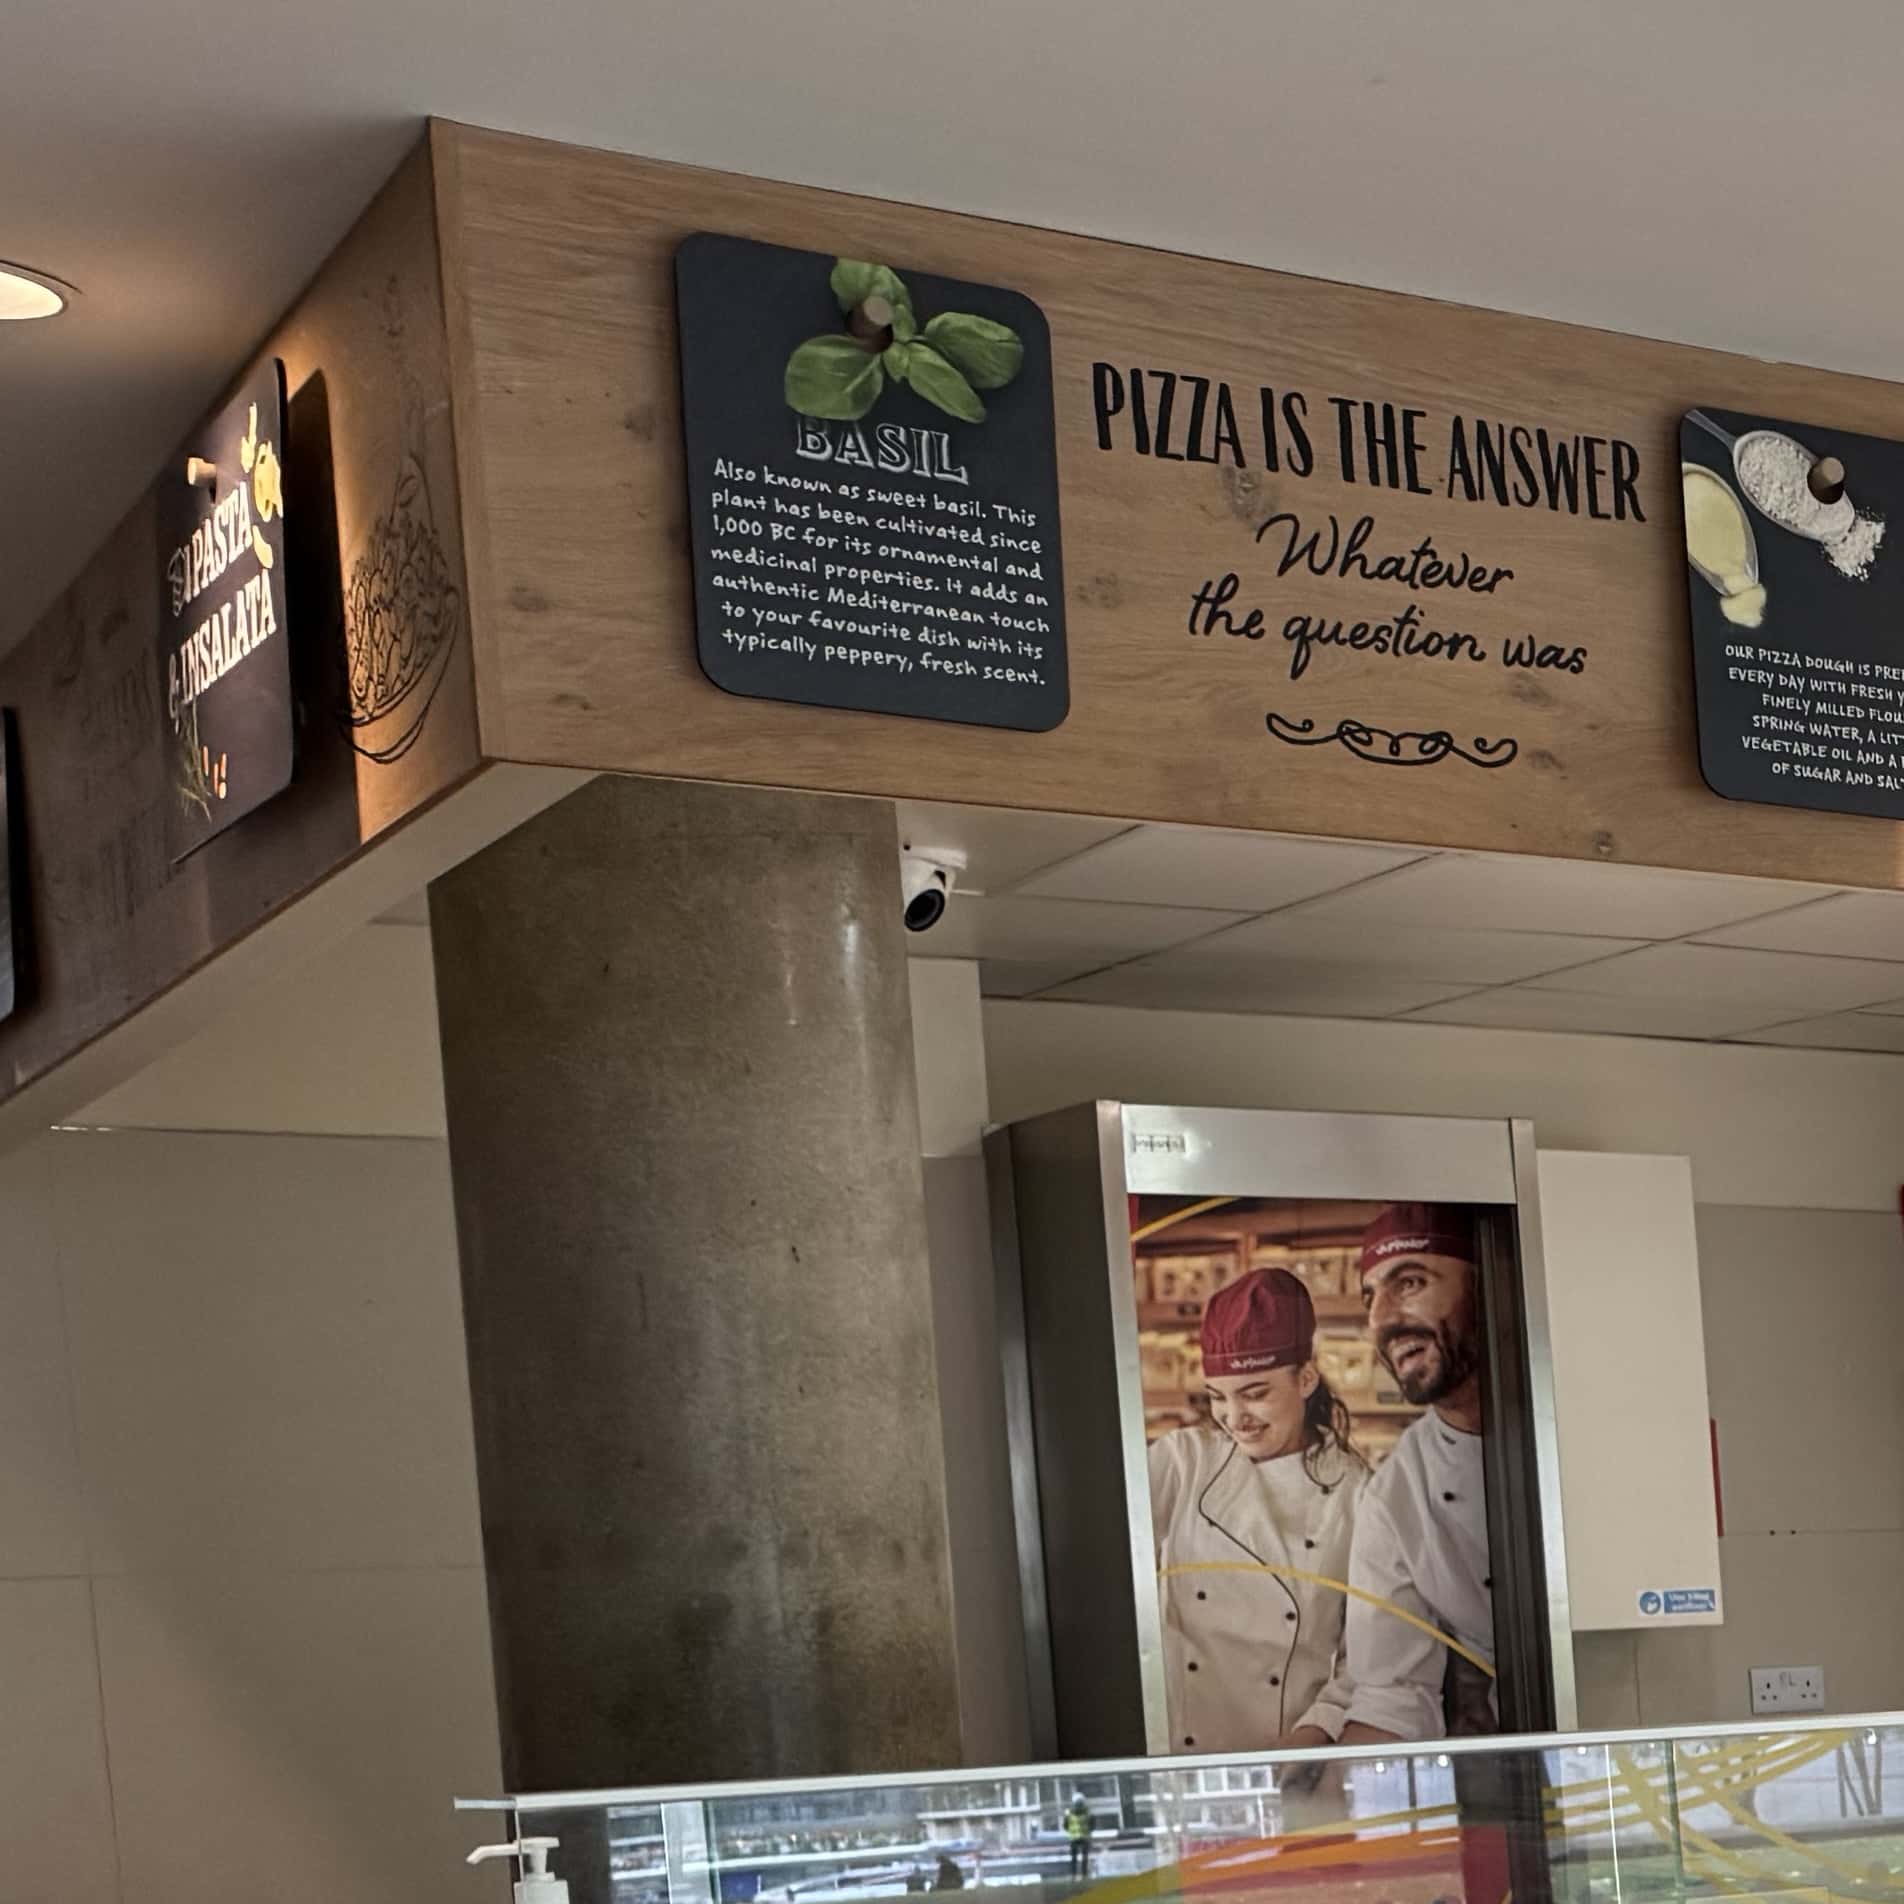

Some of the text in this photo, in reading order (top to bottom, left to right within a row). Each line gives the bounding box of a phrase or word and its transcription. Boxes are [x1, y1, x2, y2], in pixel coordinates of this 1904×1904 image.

[795, 420, 969, 485] BASIL
[1093, 363, 1646, 523] PIZZA IS THE ANSWER
[712, 488, 1041, 553] plant has been cultivated since
[714, 458, 1036, 527] Also known as sweet basil. This
[712, 547, 1048, 606] medicinal properties. It adds an
[714, 515, 1043, 580] 1,000 BC for its ornamental and
[1256, 513, 1514, 593] Whatever
[713, 576, 1049, 632] authentic Mediterranean touch
[722, 601, 1042, 659] to your favourite dish with its
[1189, 573, 1587, 680] the question was
[181, 569, 276, 705] INSALATA
[722, 629, 1045, 685] typically peppery, fresh scent.
[1726, 645, 1754, 659] OUR
[1759, 648, 1801, 668] PIZZA
[1806, 656, 1853, 673] DOUGH
[1859, 664, 1870, 675] IS
[1729, 668, 1774, 688] EVERY
[1779, 674, 1805, 693] DAY
[1810, 679, 1846, 694] WITH
[1851, 684, 1892, 700] FRESH
[1763, 694, 1810, 715] FINELY
[1816, 702, 1864, 718] MILLED
[1742, 736, 1827, 757] VEGETABLE
[1832, 748, 1852, 761] OIL
[1857, 750, 1884, 764] AND
[1889, 754, 1897, 768] A
[1753, 715, 1805, 733] SPRING
[1810, 723, 1863, 744] WATER,
[1868, 730, 1876, 743] A
[1772, 763, 1789, 774] OF
[1794, 765, 1841, 782] SUGAR
[1846, 770, 1873, 784] AND
